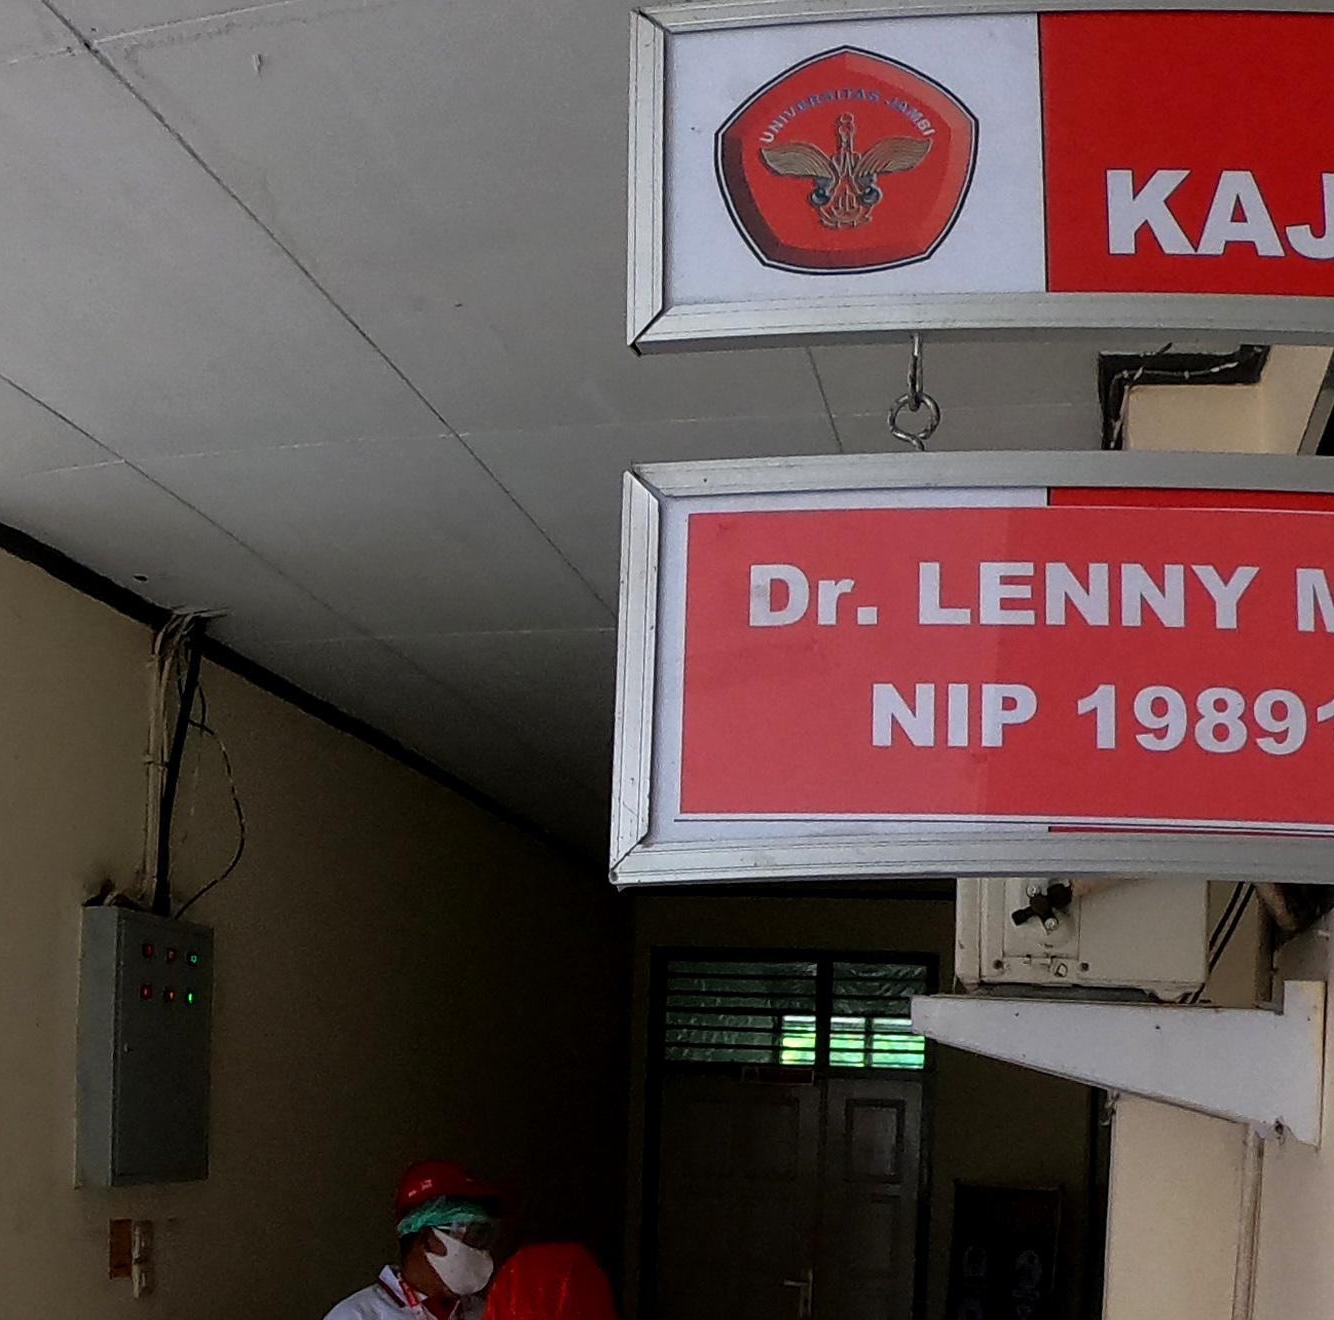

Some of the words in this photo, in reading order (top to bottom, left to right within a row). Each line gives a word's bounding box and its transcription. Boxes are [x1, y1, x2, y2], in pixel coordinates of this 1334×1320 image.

[760, 88, 880, 143] UNIVERSITAS
[885, 97, 935, 136] JAMBI
[747, 563, 879, 627] Dr.
[917, 561, 1260, 631] LENNY
[870, 682, 1038, 749] NIP
